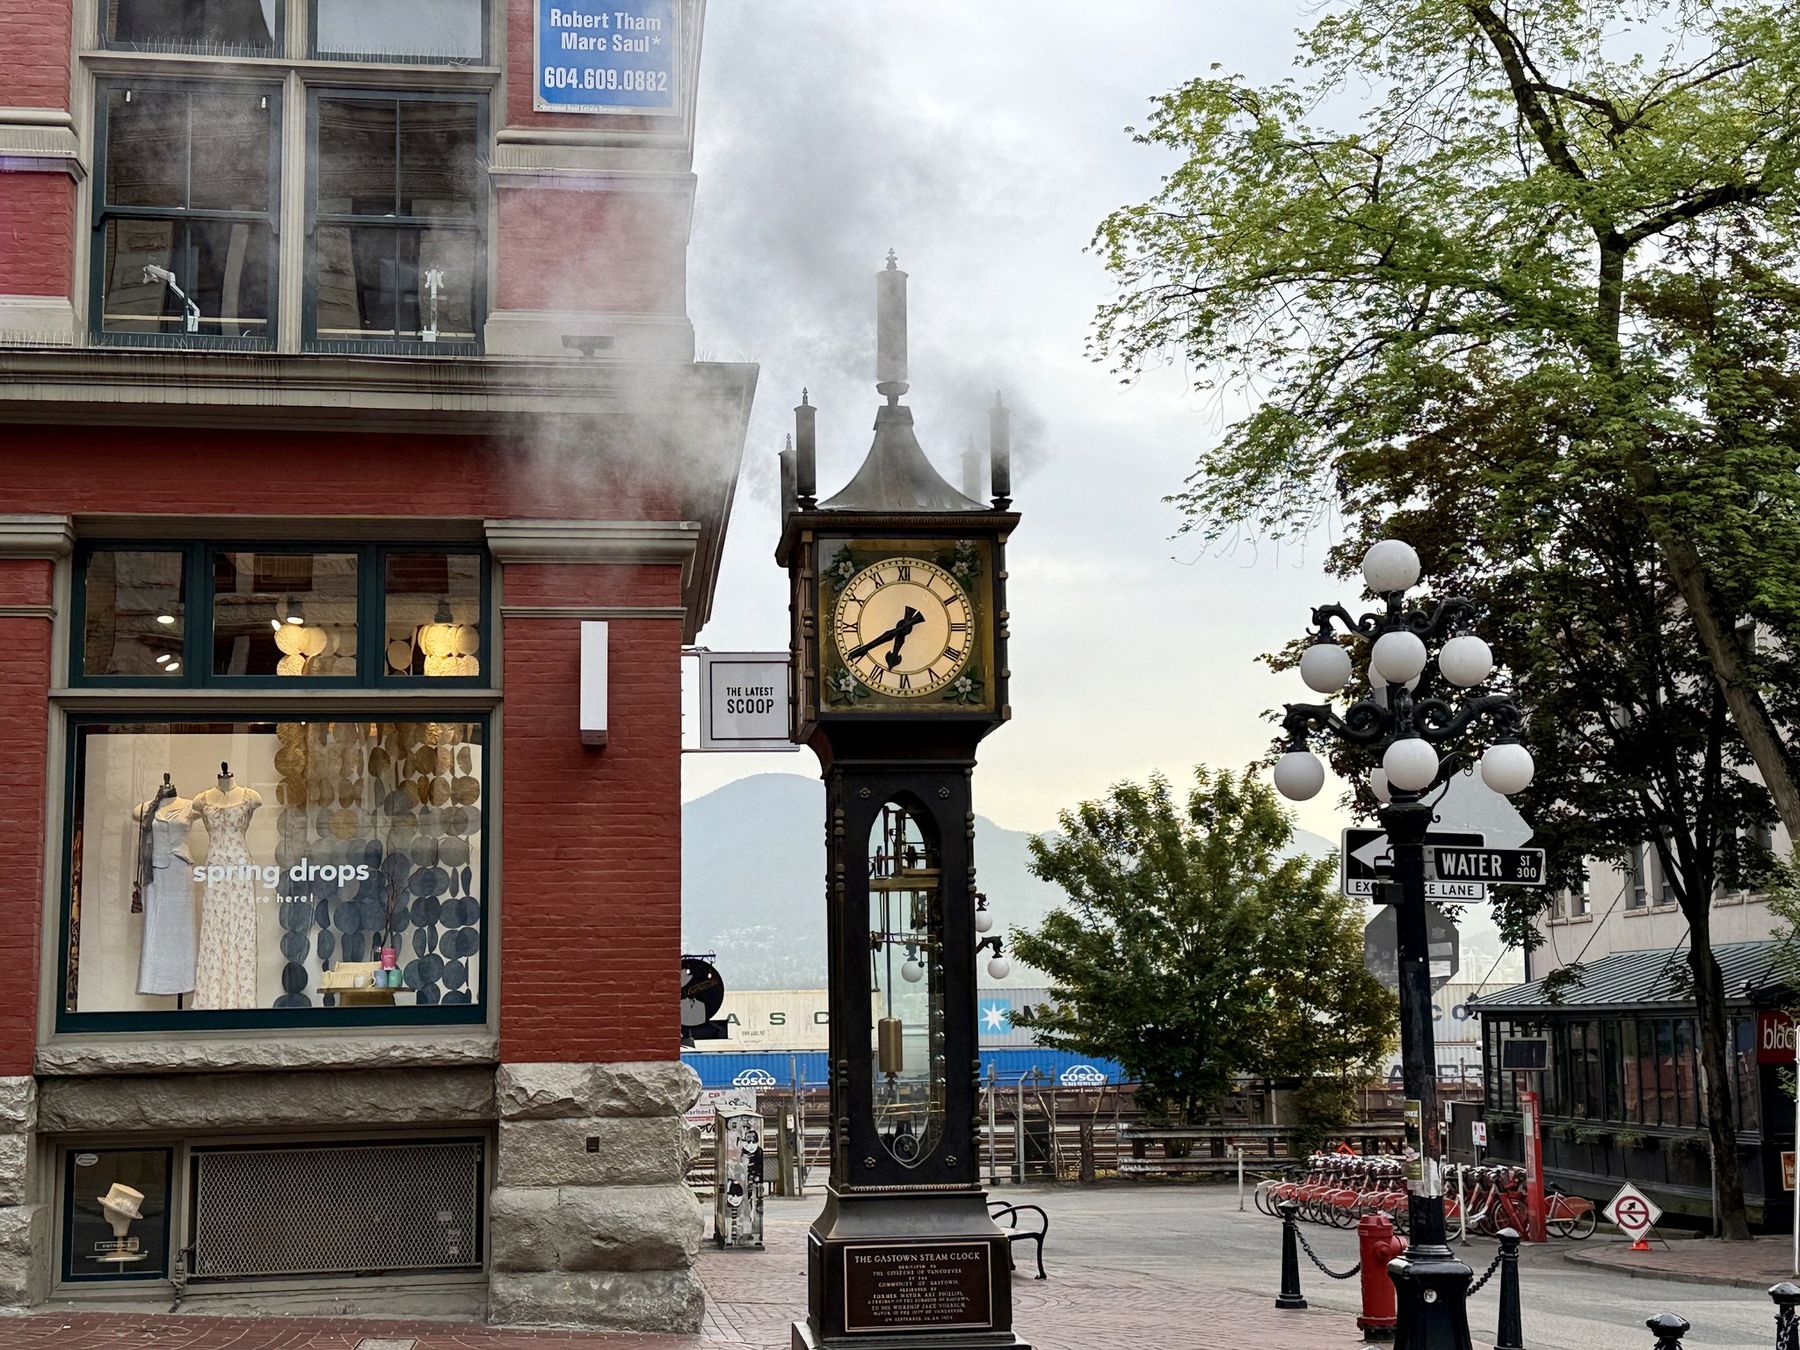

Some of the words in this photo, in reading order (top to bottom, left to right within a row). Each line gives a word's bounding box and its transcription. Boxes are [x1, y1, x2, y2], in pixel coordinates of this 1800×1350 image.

[550, 8, 609, 29] Robert
[614, 12, 662, 31] Tham
[561, 32, 607, 51] Marc
[544, 66, 668, 92] 604.609.0882
[726, 686, 741, 696] THE
[745, 686, 774, 696] LATEST
[727, 698, 774, 714] SCOOP
[1441, 852, 1503, 877] WATER
[1520, 855, 1530, 866] ST
[193, 857, 280, 889] spring
[289, 857, 370, 888] drops
[1516, 867, 1537, 878] 300
[1441, 884, 1474, 896] LANE
[276, 893, 314, 904] here!
[732, 1077, 776, 1086] COSCO
[1060, 1073, 1105, 1082] COSCO
[855, 1255, 872, 1264] THE
[874, 1254, 918, 1263] GASTOWN
[920, 1253, 948, 1262] STEAM
[950, 1252, 980, 1261] CLOCK
